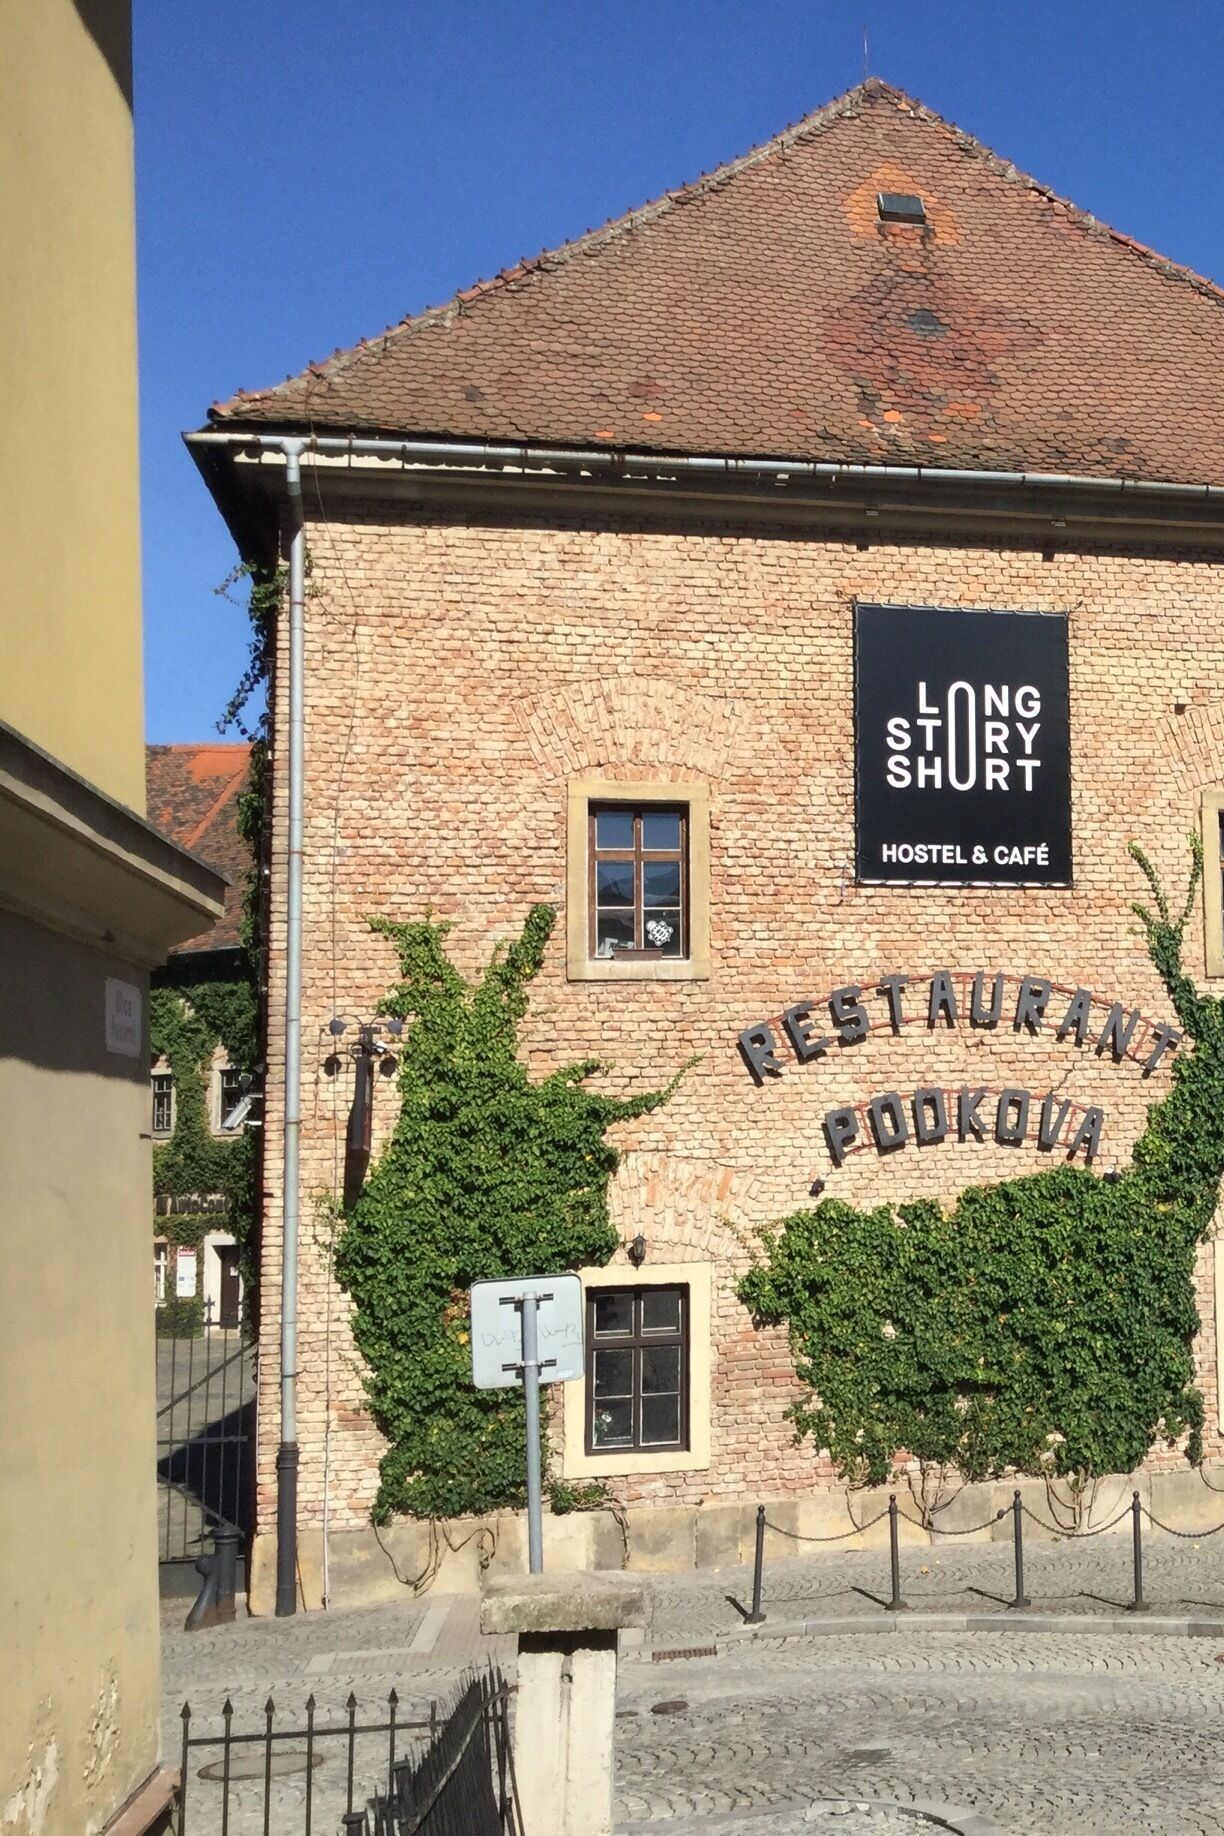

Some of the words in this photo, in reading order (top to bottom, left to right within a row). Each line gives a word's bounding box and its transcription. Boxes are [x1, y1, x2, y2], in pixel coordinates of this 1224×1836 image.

[918, 682, 1041, 718] LONG
[886, 717, 1041, 755] STORY
[886, 755, 1041, 791] SHORT
[882, 843, 968, 865] HOSTEL
[971, 846, 989, 865] &
[994, 842, 1049, 866] CAFÉ
[738, 970, 1184, 1082] RESTAURANT
[825, 1086, 1104, 1161] PODKOVA
